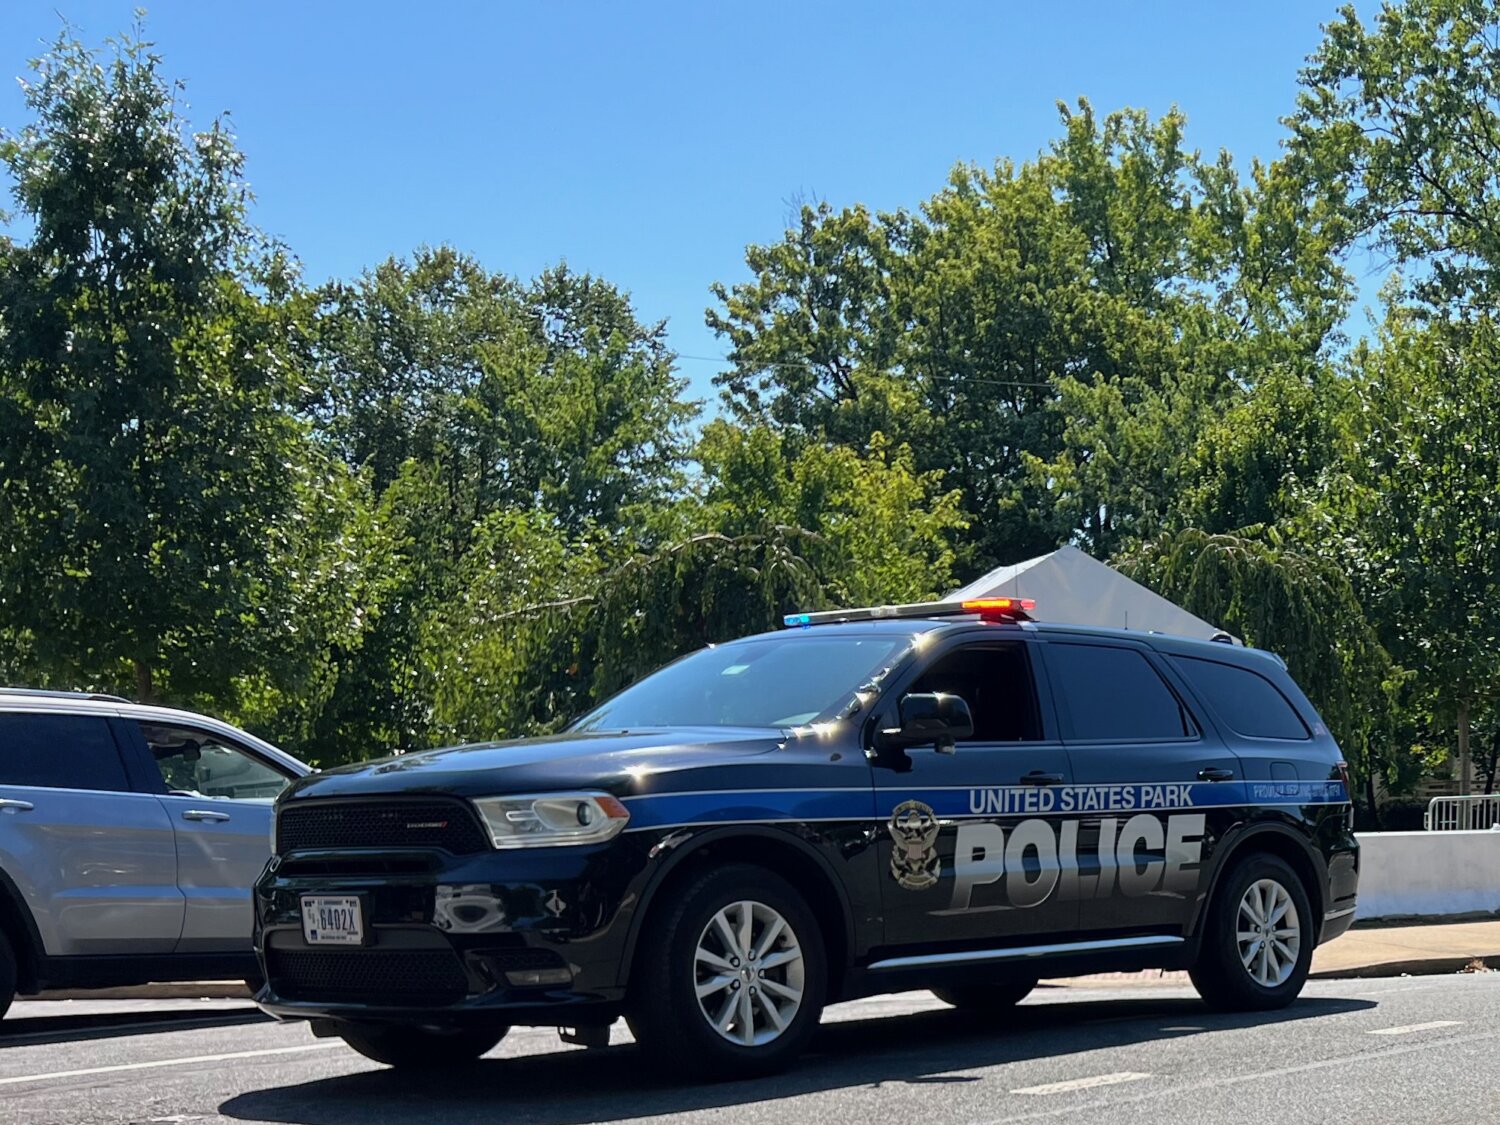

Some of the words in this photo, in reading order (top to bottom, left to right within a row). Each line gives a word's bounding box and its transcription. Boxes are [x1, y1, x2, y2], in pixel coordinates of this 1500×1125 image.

[969, 789, 1054, 814] UNITED
[1060, 786, 1135, 811] STATES
[1141, 784, 1193, 807] PARK
[951, 813, 1206, 909] POLICE
[320, 908, 356, 931] 6402X
